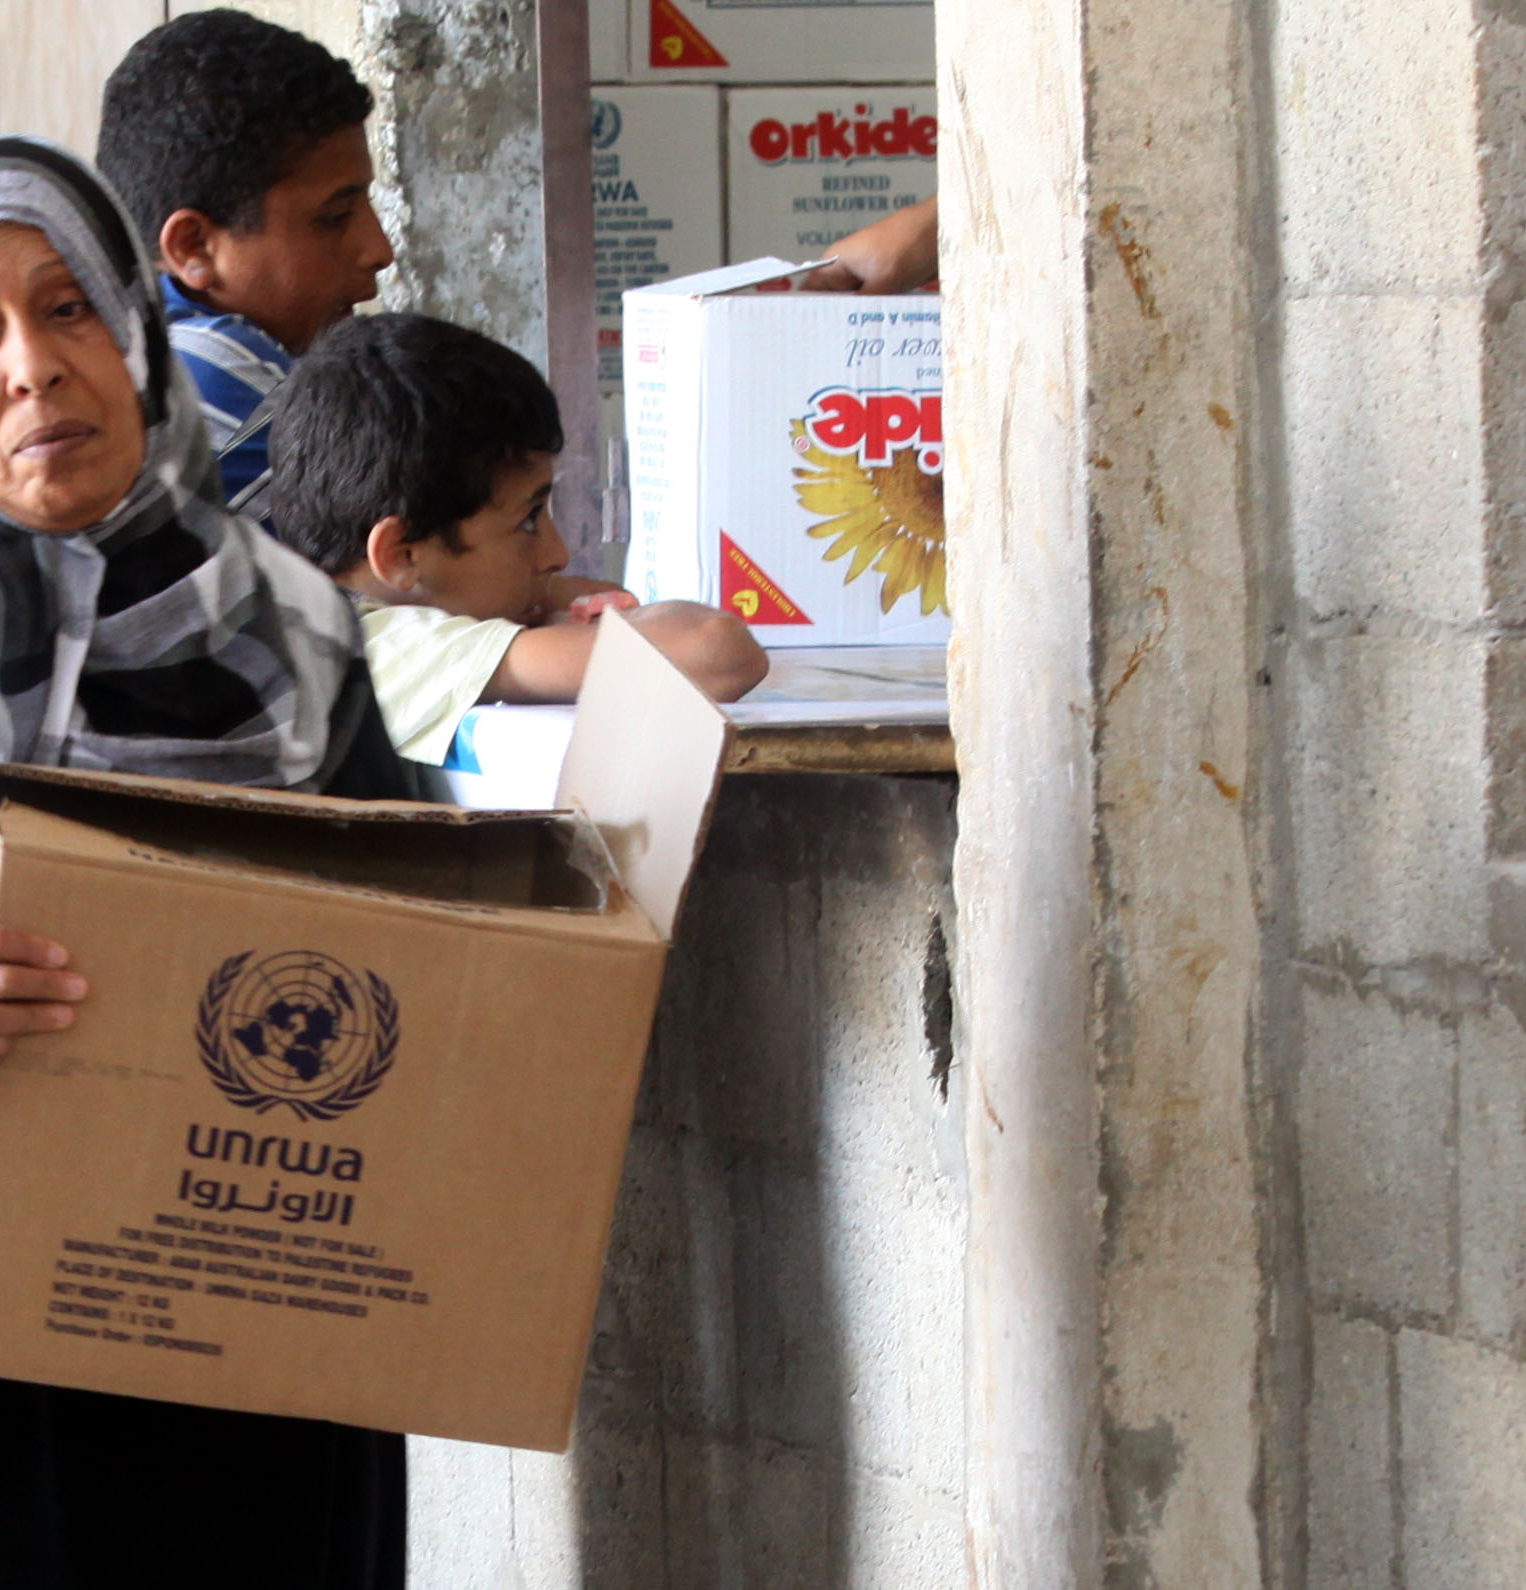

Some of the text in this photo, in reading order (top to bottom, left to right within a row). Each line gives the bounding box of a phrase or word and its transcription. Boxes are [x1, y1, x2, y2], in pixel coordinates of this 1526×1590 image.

[822, 175, 891, 192] REFINED
[792, 195, 889, 212] SUNFLOWER
[848, 312, 941, 326] itamin A and D
[812, 393, 942, 467] ide
[185, 1123, 364, 1182] unrwa
